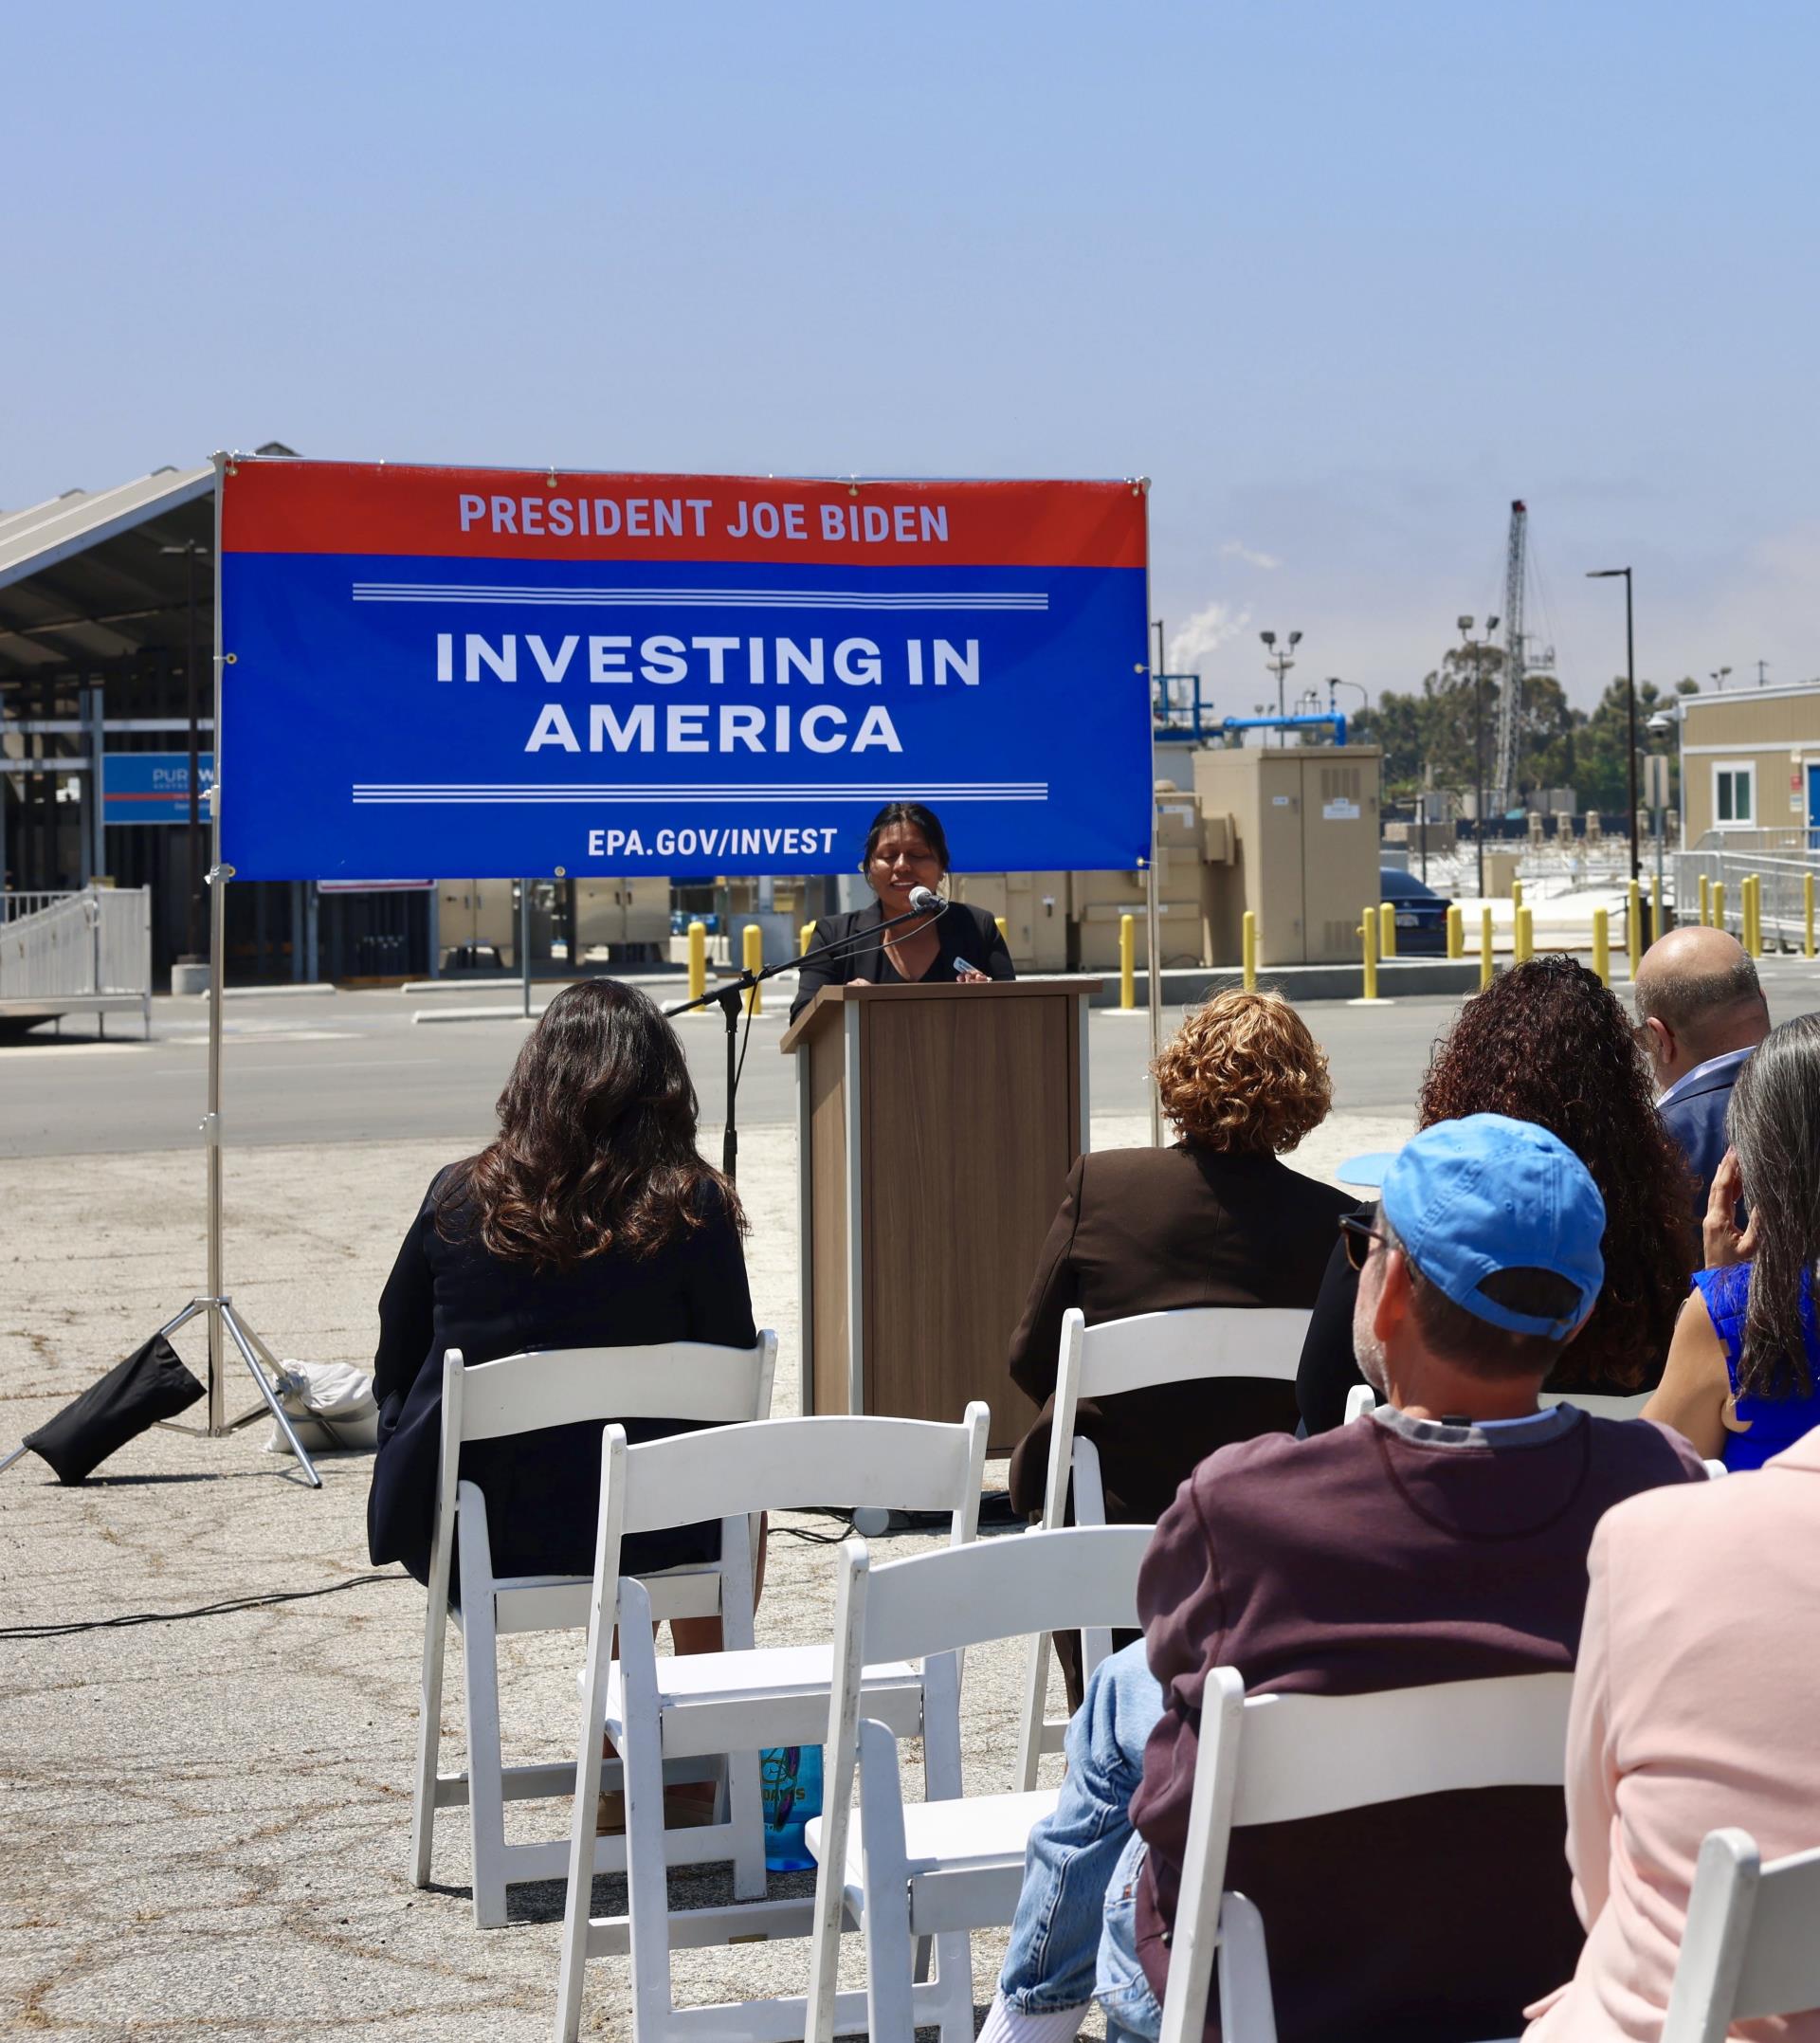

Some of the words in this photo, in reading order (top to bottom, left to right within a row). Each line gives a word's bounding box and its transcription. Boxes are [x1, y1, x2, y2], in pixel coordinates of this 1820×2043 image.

[460, 494, 712, 538] PRESIDENT
[727, 501, 808, 540] JOE
[820, 504, 949, 542] BIDEN
[437, 633, 883, 686] INVESTING
[906, 639, 980, 686] IN
[523, 703, 903, 754] AMERICA
[588, 828, 838, 857] EPA.GOV/INVEST
